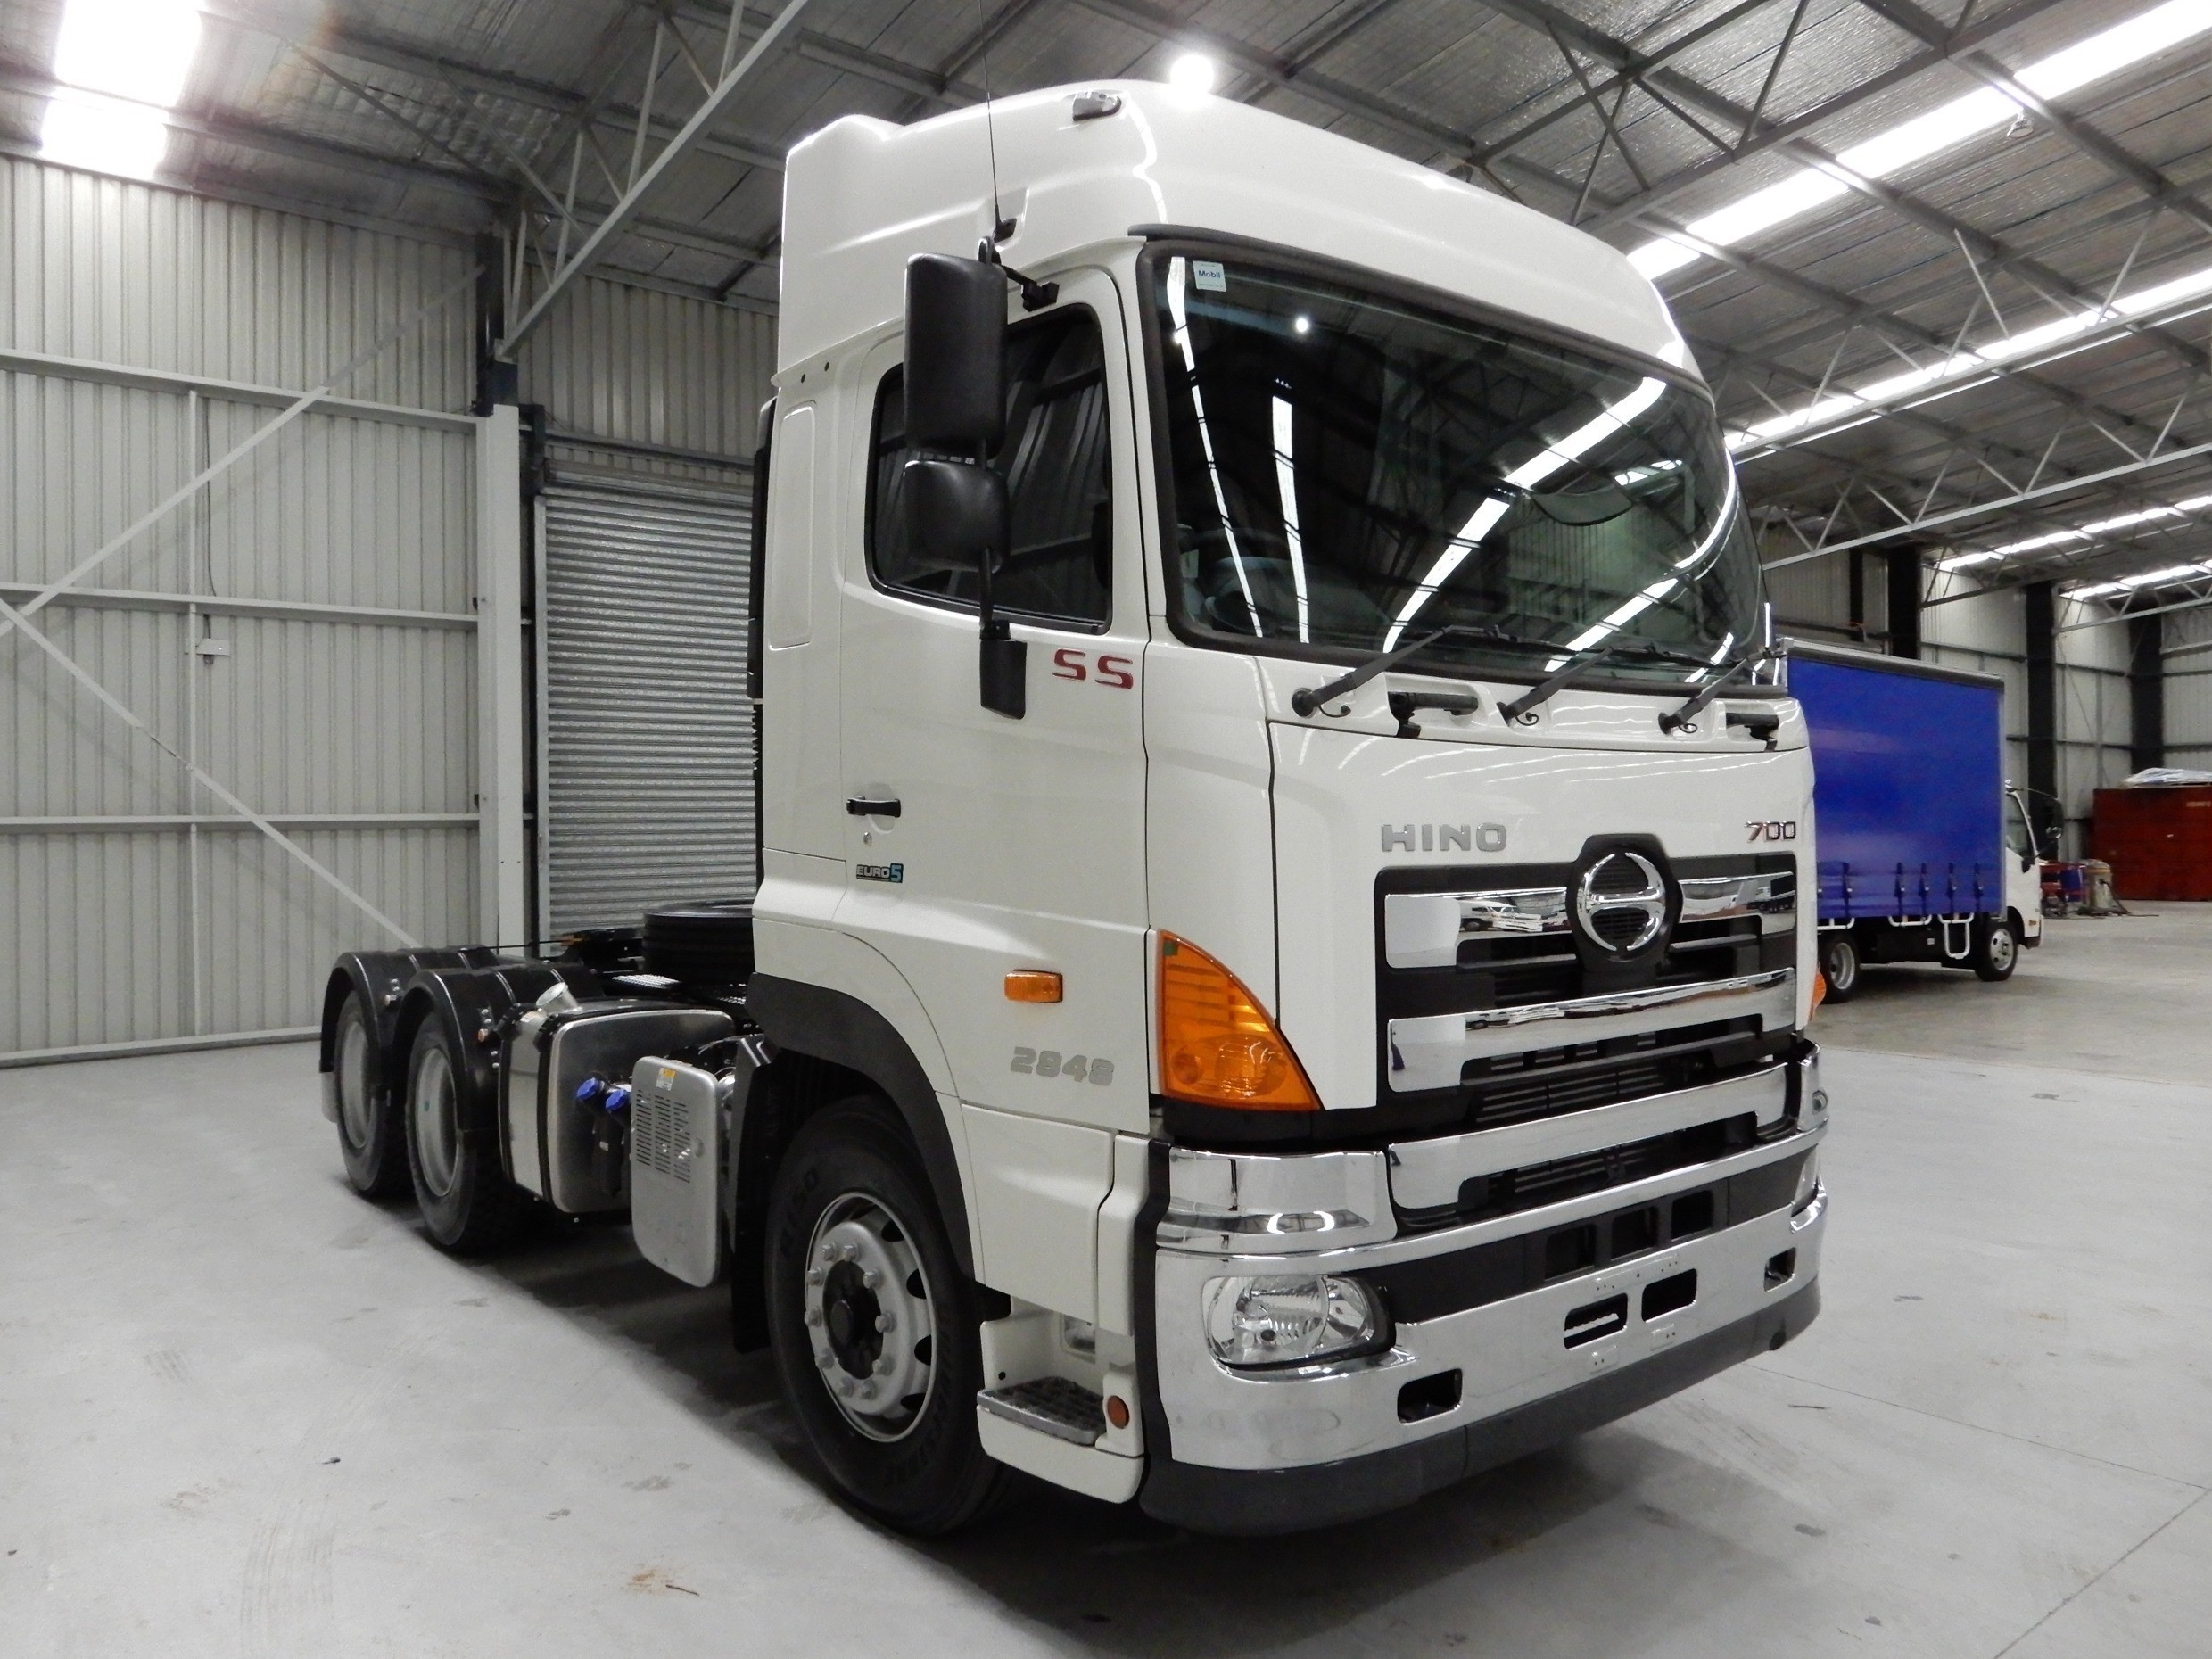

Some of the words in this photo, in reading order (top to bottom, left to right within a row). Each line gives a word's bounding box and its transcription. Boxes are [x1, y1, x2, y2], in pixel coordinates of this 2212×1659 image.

[1198, 270, 1221, 278] Mobil
[1052, 648, 1134, 690] SS
[1381, 822, 1507, 852] HINO
[1745, 821, 1796, 842] 700
[1010, 1046, 1115, 1086] 2848
